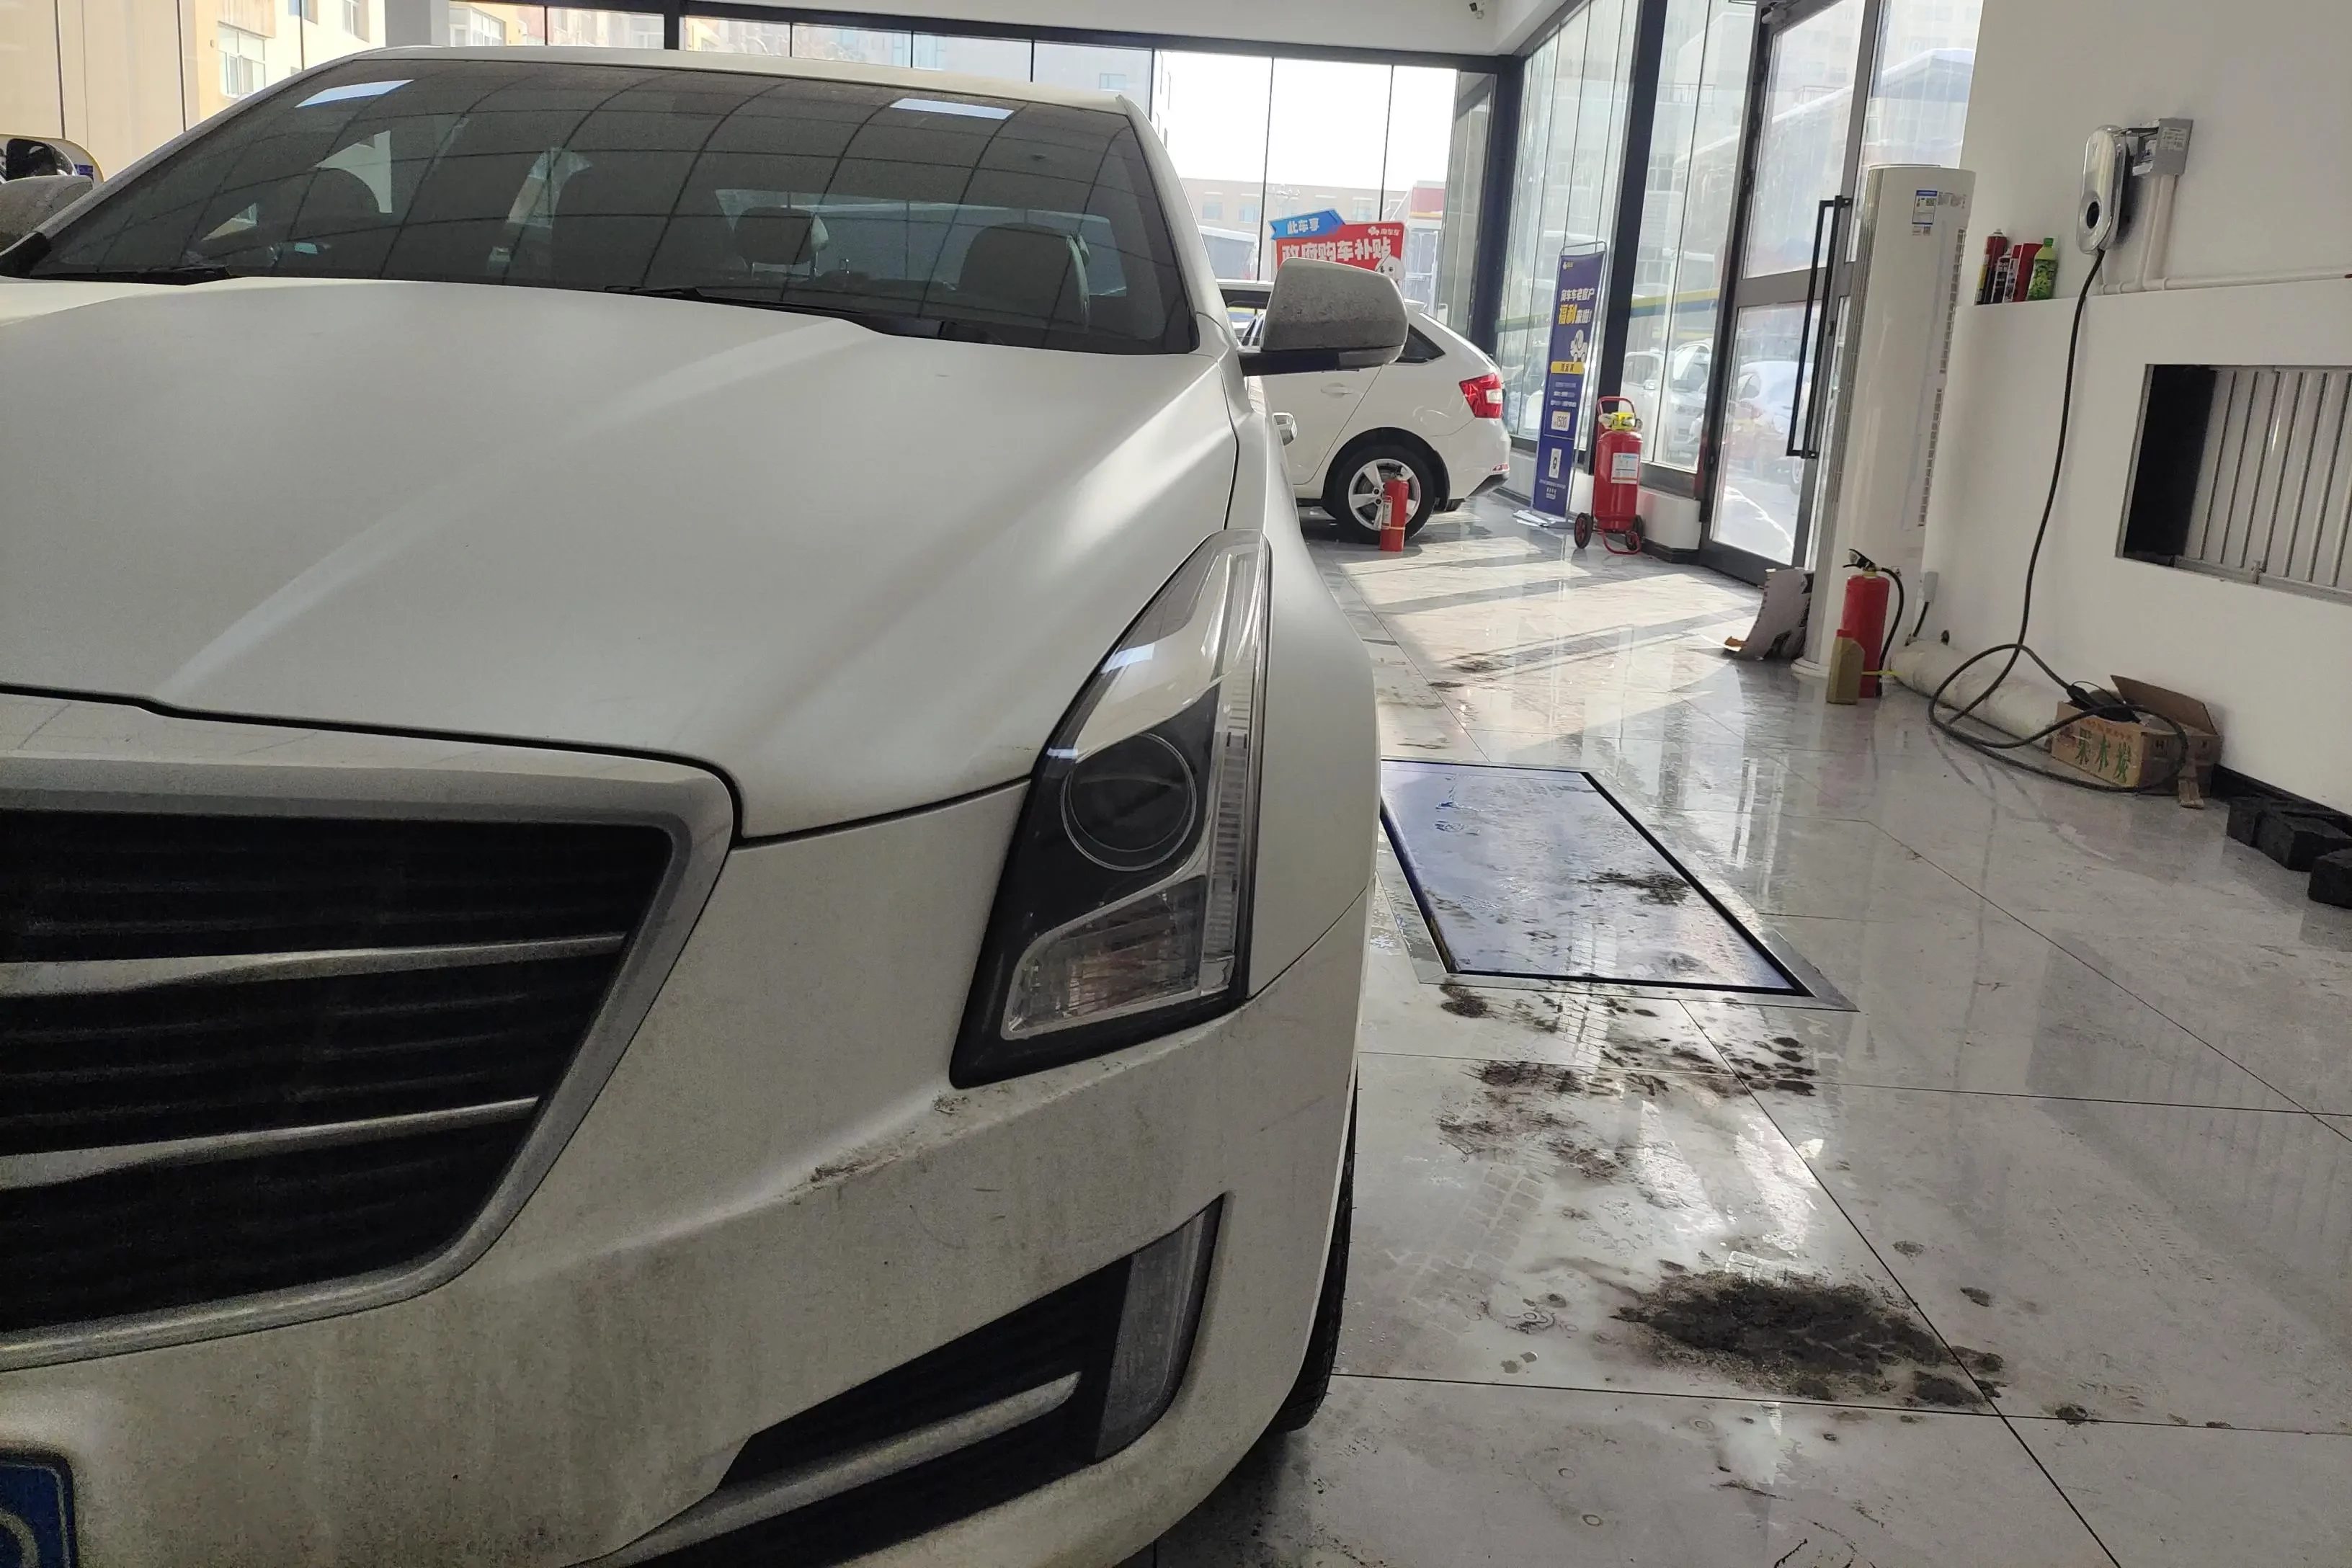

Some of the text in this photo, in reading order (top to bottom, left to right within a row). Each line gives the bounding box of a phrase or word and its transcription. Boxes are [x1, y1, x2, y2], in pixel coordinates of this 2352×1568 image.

[1287, 218, 1319, 234] 此车享
[1281, 236, 1391, 262] 政府购车补贴
